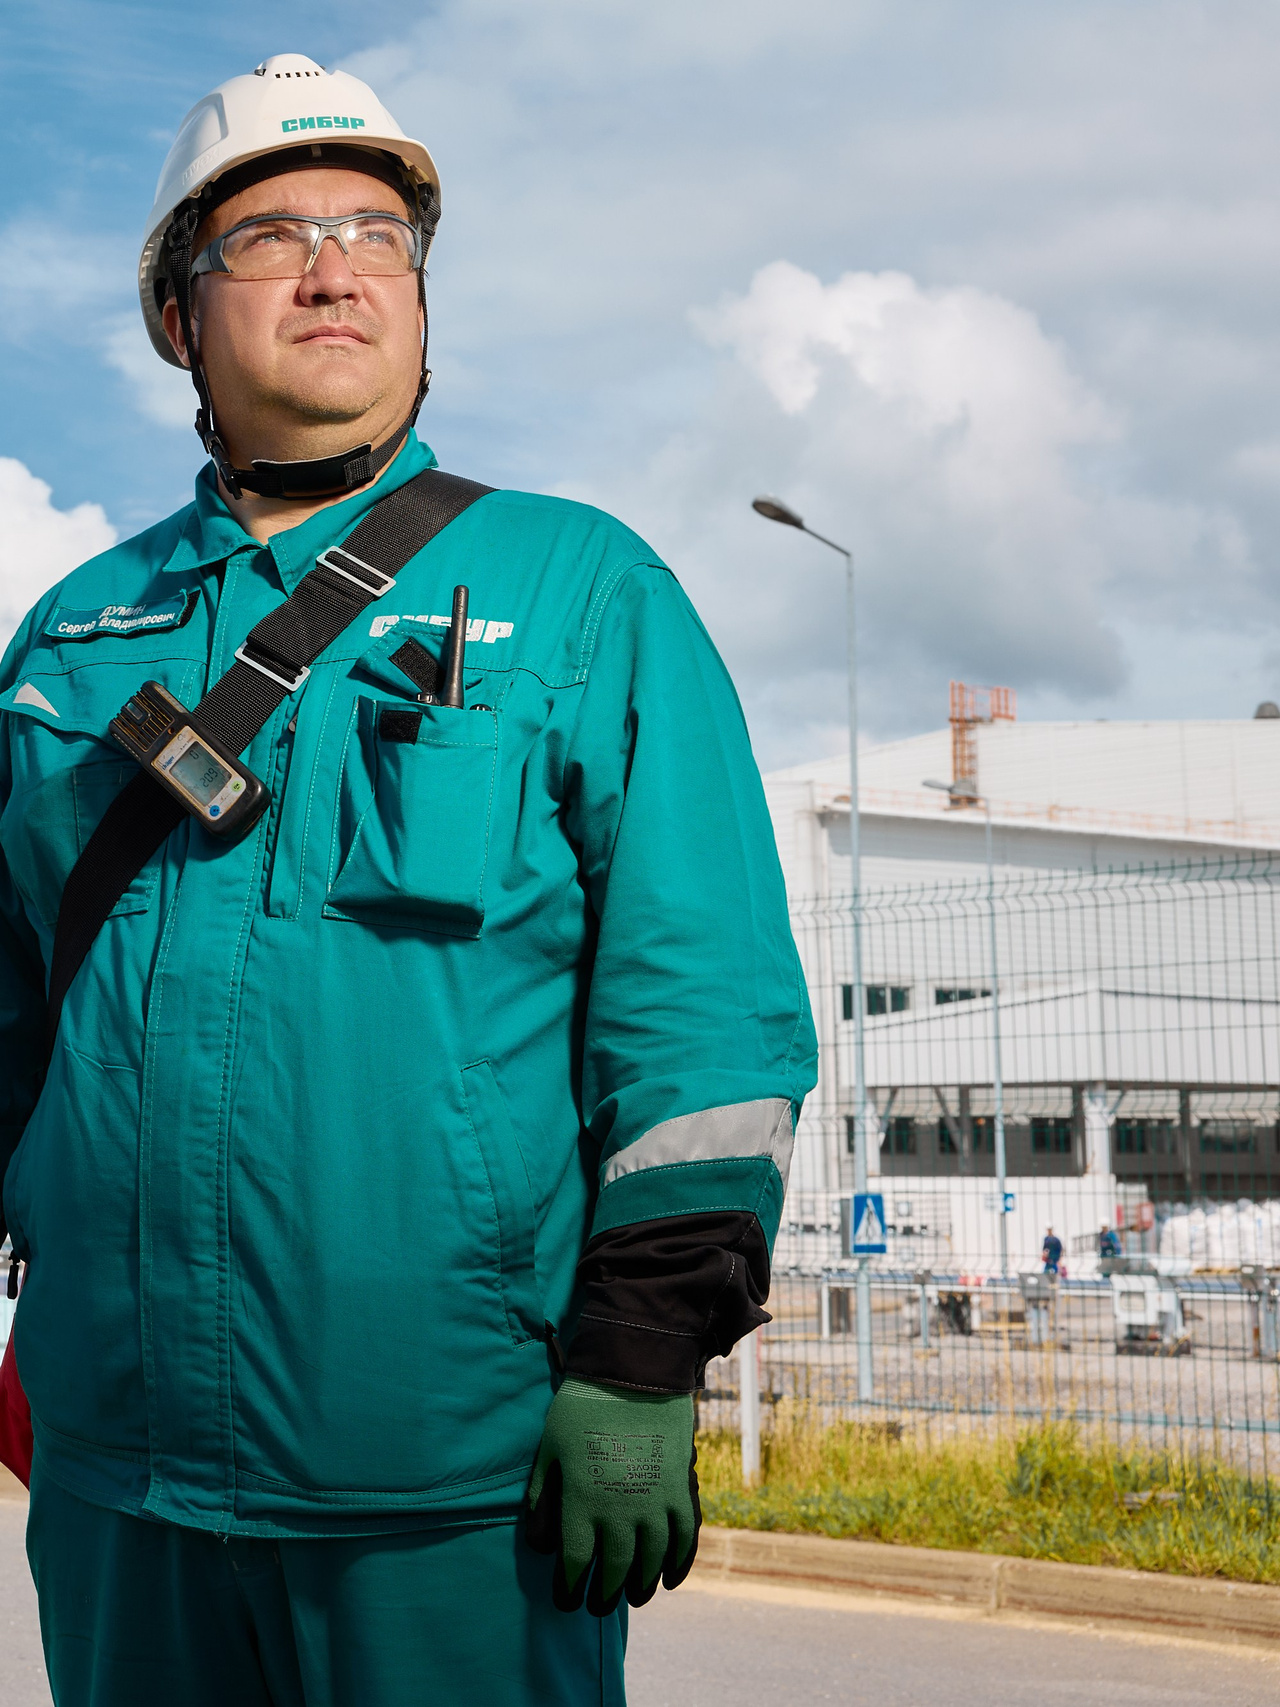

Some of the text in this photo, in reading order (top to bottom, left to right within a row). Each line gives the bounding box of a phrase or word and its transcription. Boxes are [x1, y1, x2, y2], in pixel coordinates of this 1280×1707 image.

[281, 116, 365, 133] СИБУР
[99, 604, 146, 619] ДУМИН
[58, 620, 96, 635] Сергей
